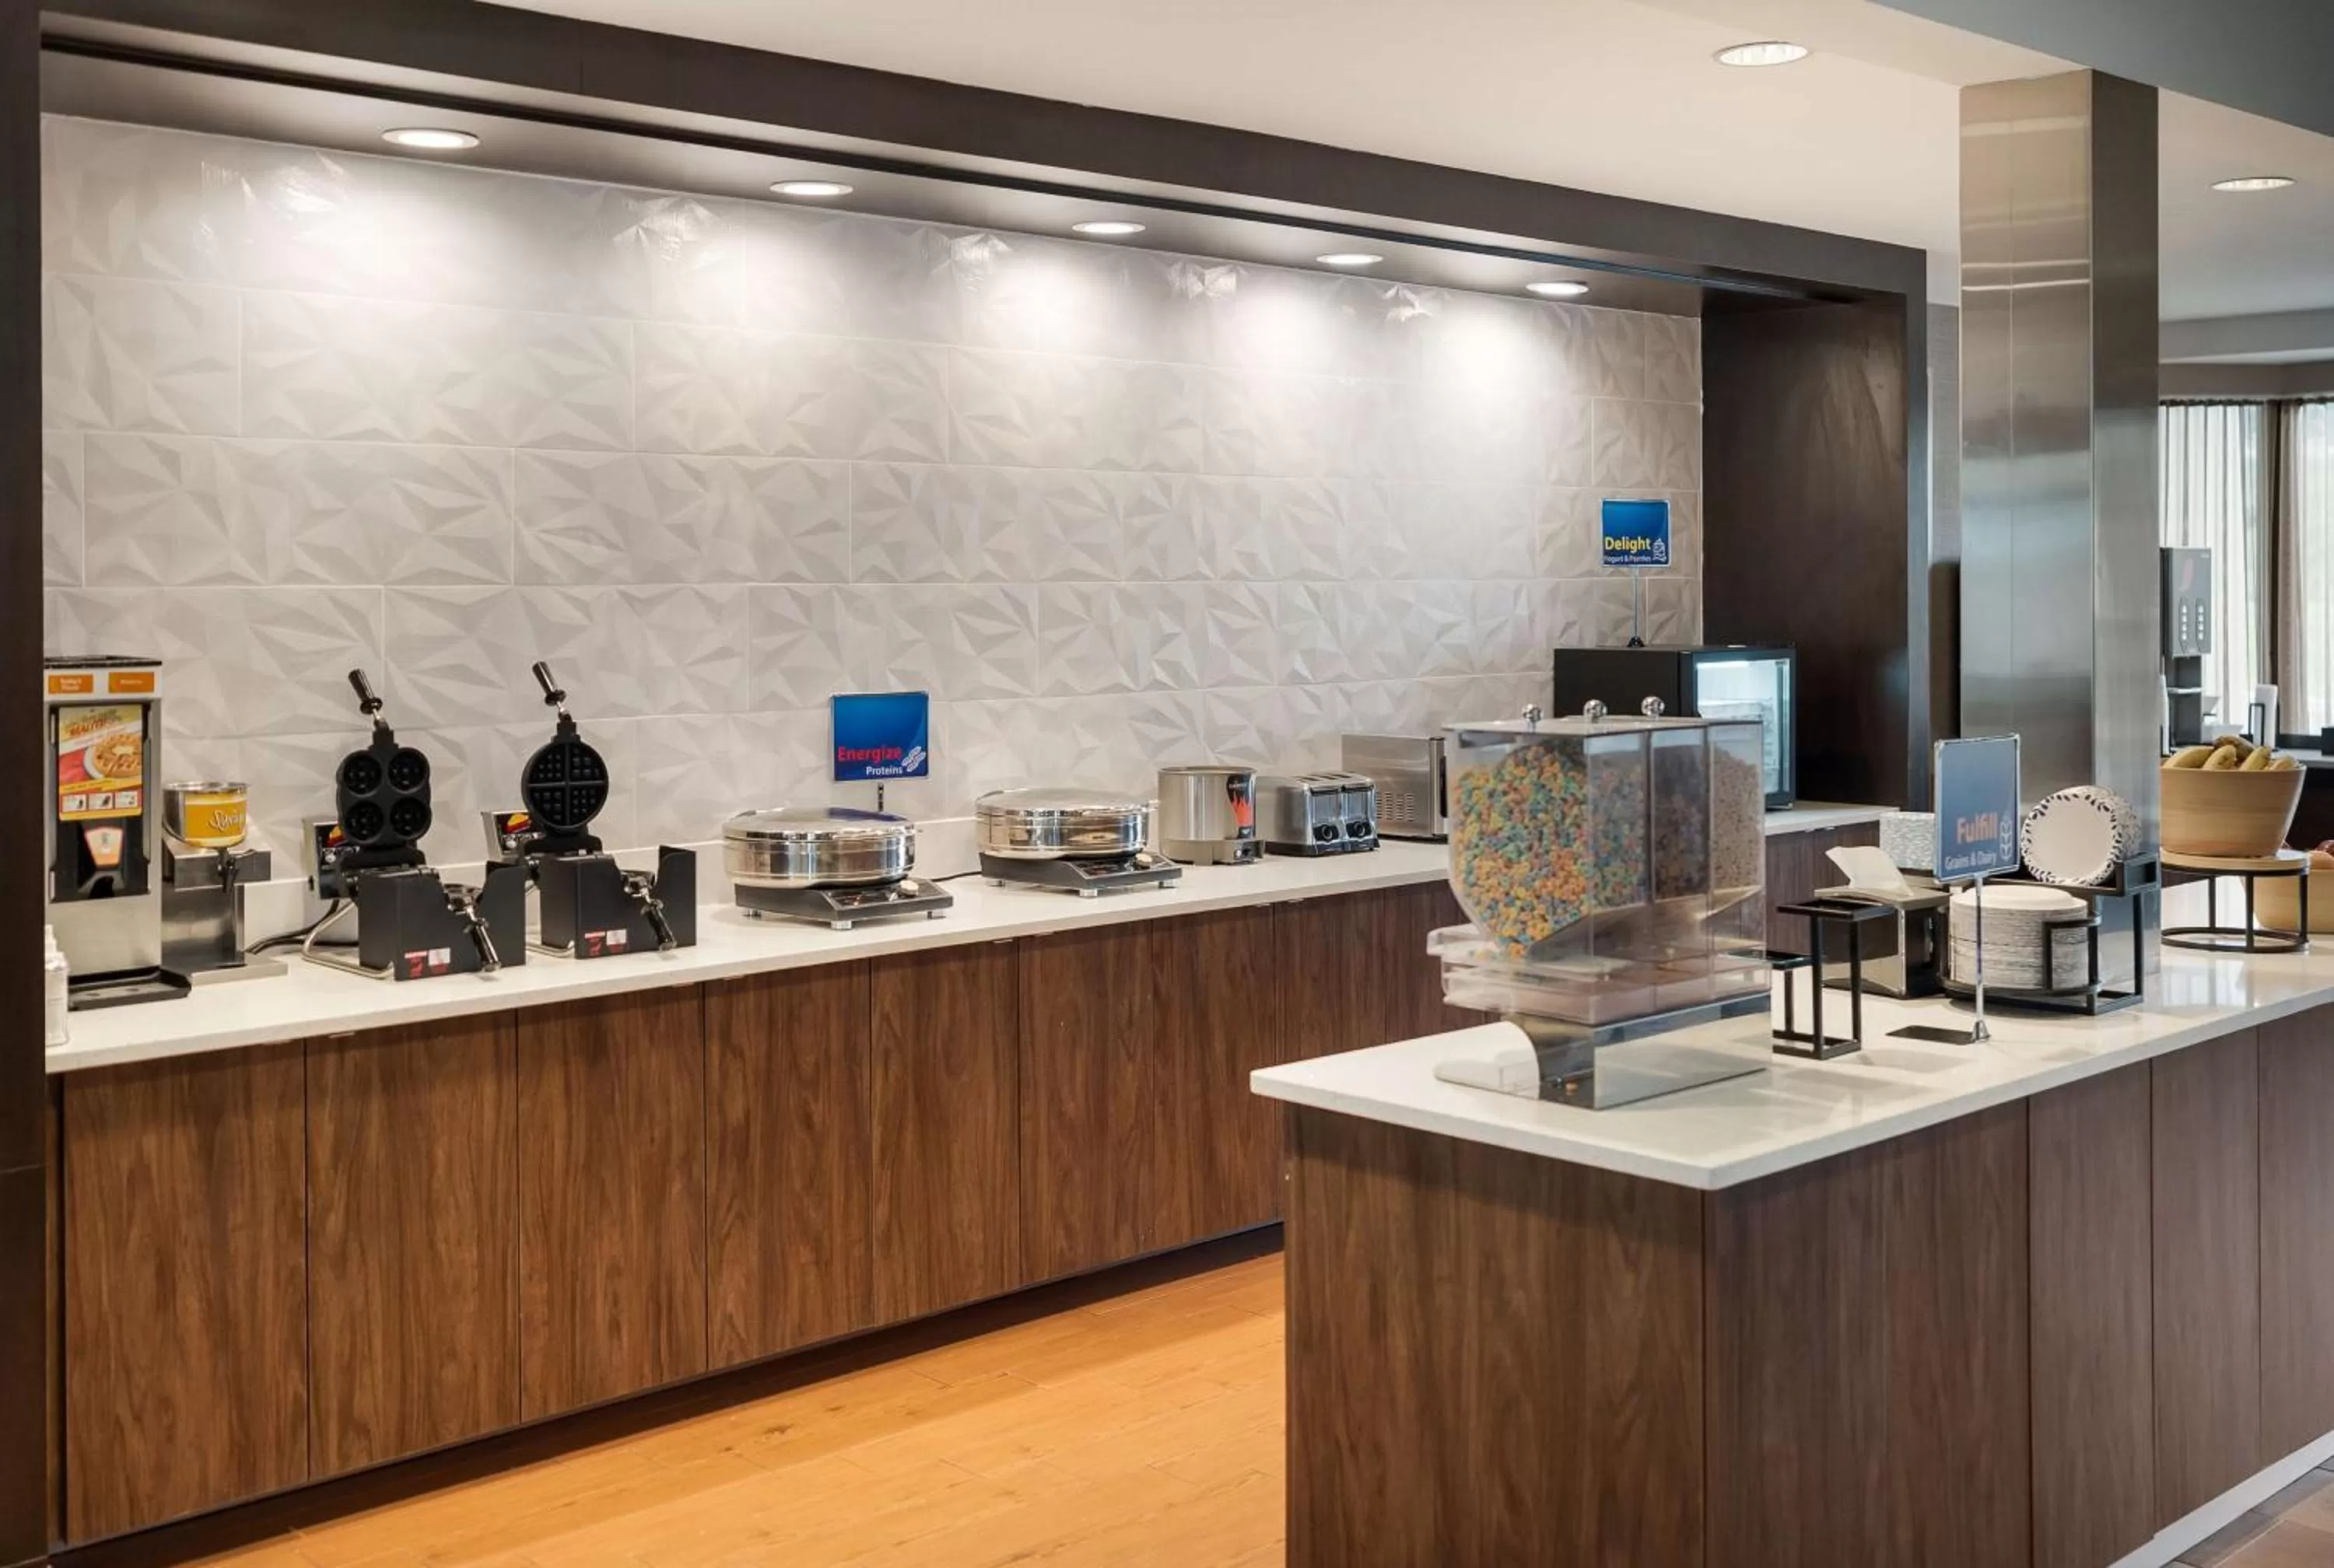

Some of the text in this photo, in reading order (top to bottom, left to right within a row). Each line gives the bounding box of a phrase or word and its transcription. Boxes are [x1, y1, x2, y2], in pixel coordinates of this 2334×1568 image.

[1605, 536, 1651, 554] Delight
[838, 744, 902, 764] Energize
[866, 765, 903, 776] Proteins
[1957, 810, 1999, 845] Fulfill
[1945, 849, 1996, 870] Grains & Dairy
